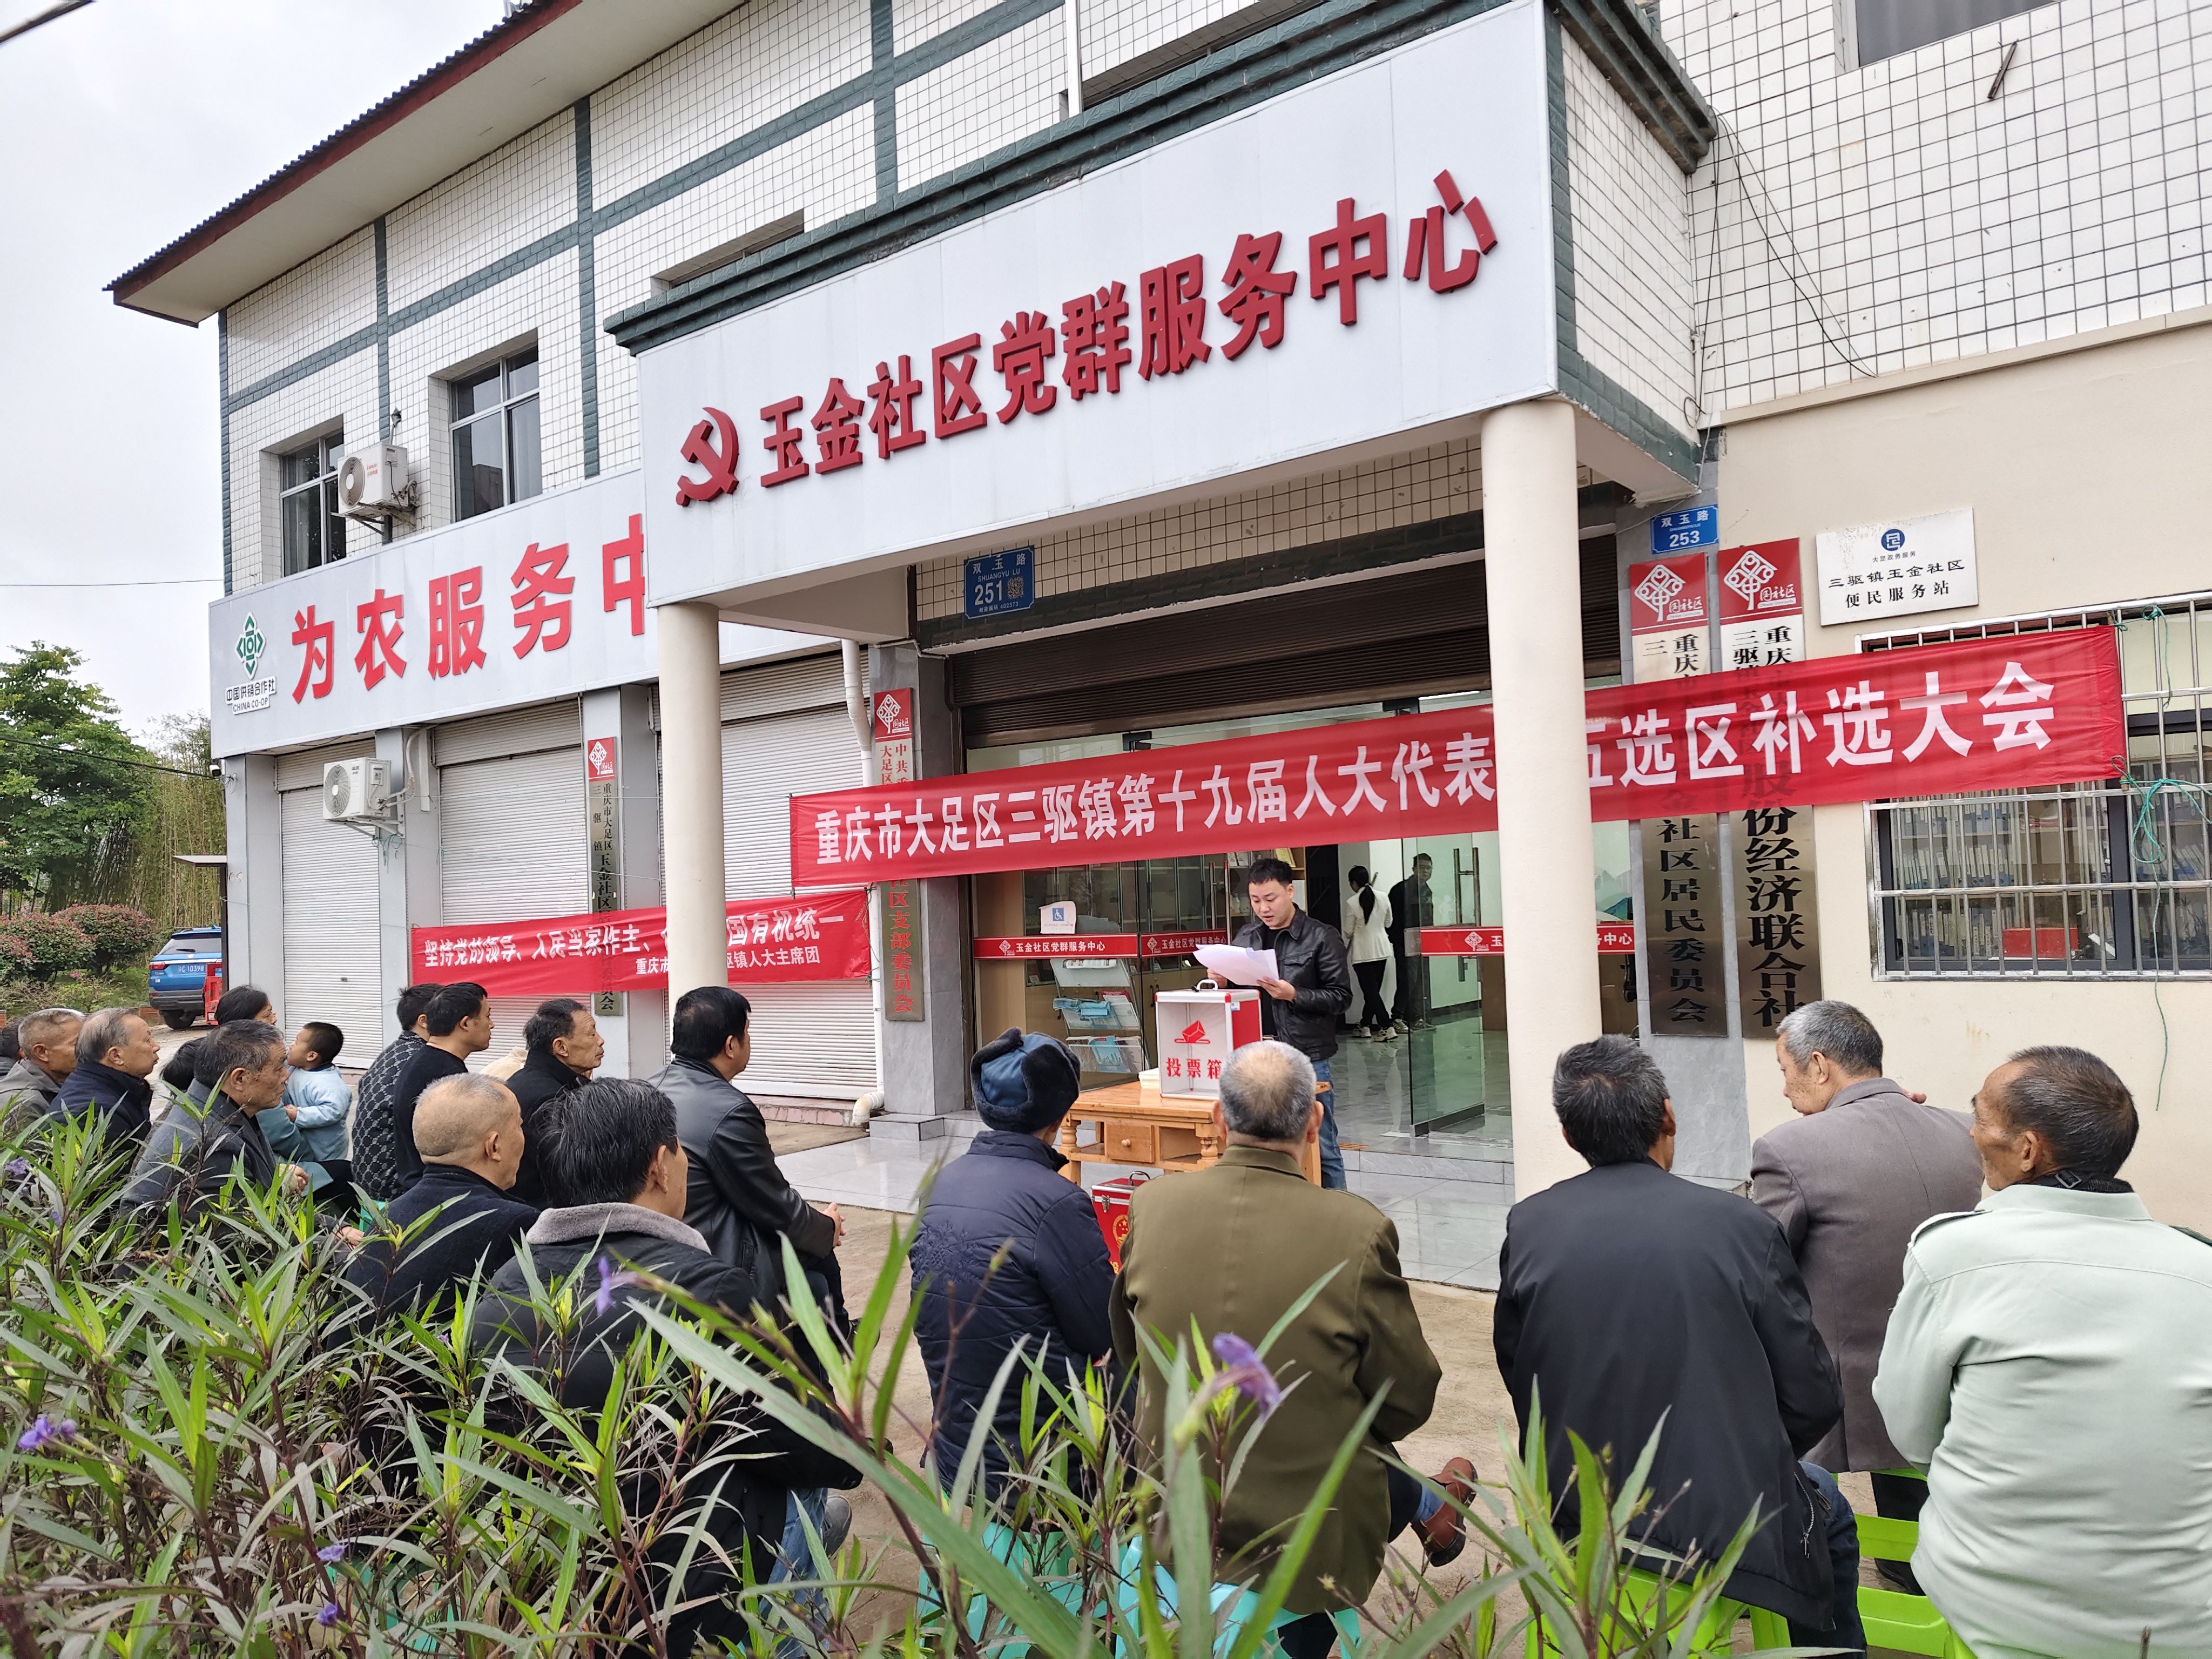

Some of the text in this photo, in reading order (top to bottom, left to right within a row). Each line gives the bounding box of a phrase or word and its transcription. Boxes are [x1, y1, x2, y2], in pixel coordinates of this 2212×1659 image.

[760, 168, 1498, 488] 玉金社区党群服务中心
[1661, 510, 1709, 527] 双玉路
[1669, 530, 1700, 547] 253
[973, 553, 1026, 574] 双玉路
[1872, 551, 1916, 563] 大足政务服务
[977, 570, 1009, 582] SHUANGYU
[1829, 559, 1965, 588] 三驱镇玉金社区
[975, 580, 1002, 605] 251
[1846, 581, 1949, 608] 便民服务站
[1643, 640, 1667, 656] 三
[1673, 633, 1700, 678] 重庆
[1732, 630, 1759, 671] 三驱
[226, 679, 275, 702] 中国供销合作社
[233, 697, 268, 712] CHINA CO-OP
[814, 662, 2055, 865] 重庆市大足区三驱镇第十九届人大代表五选区补选大会
[592, 785, 603, 852] 三驱镇
[603, 783, 612, 851] 重庆市大足区
[1656, 818, 1710, 1022] 社区居民委员会
[424, 907, 844, 967] 坚持党的领导、人民当家作主、国有机统一
[1016, 940, 1105, 953] 玉金社区党群服务中心
[1166, 1057, 1222, 1080] 投票箱
